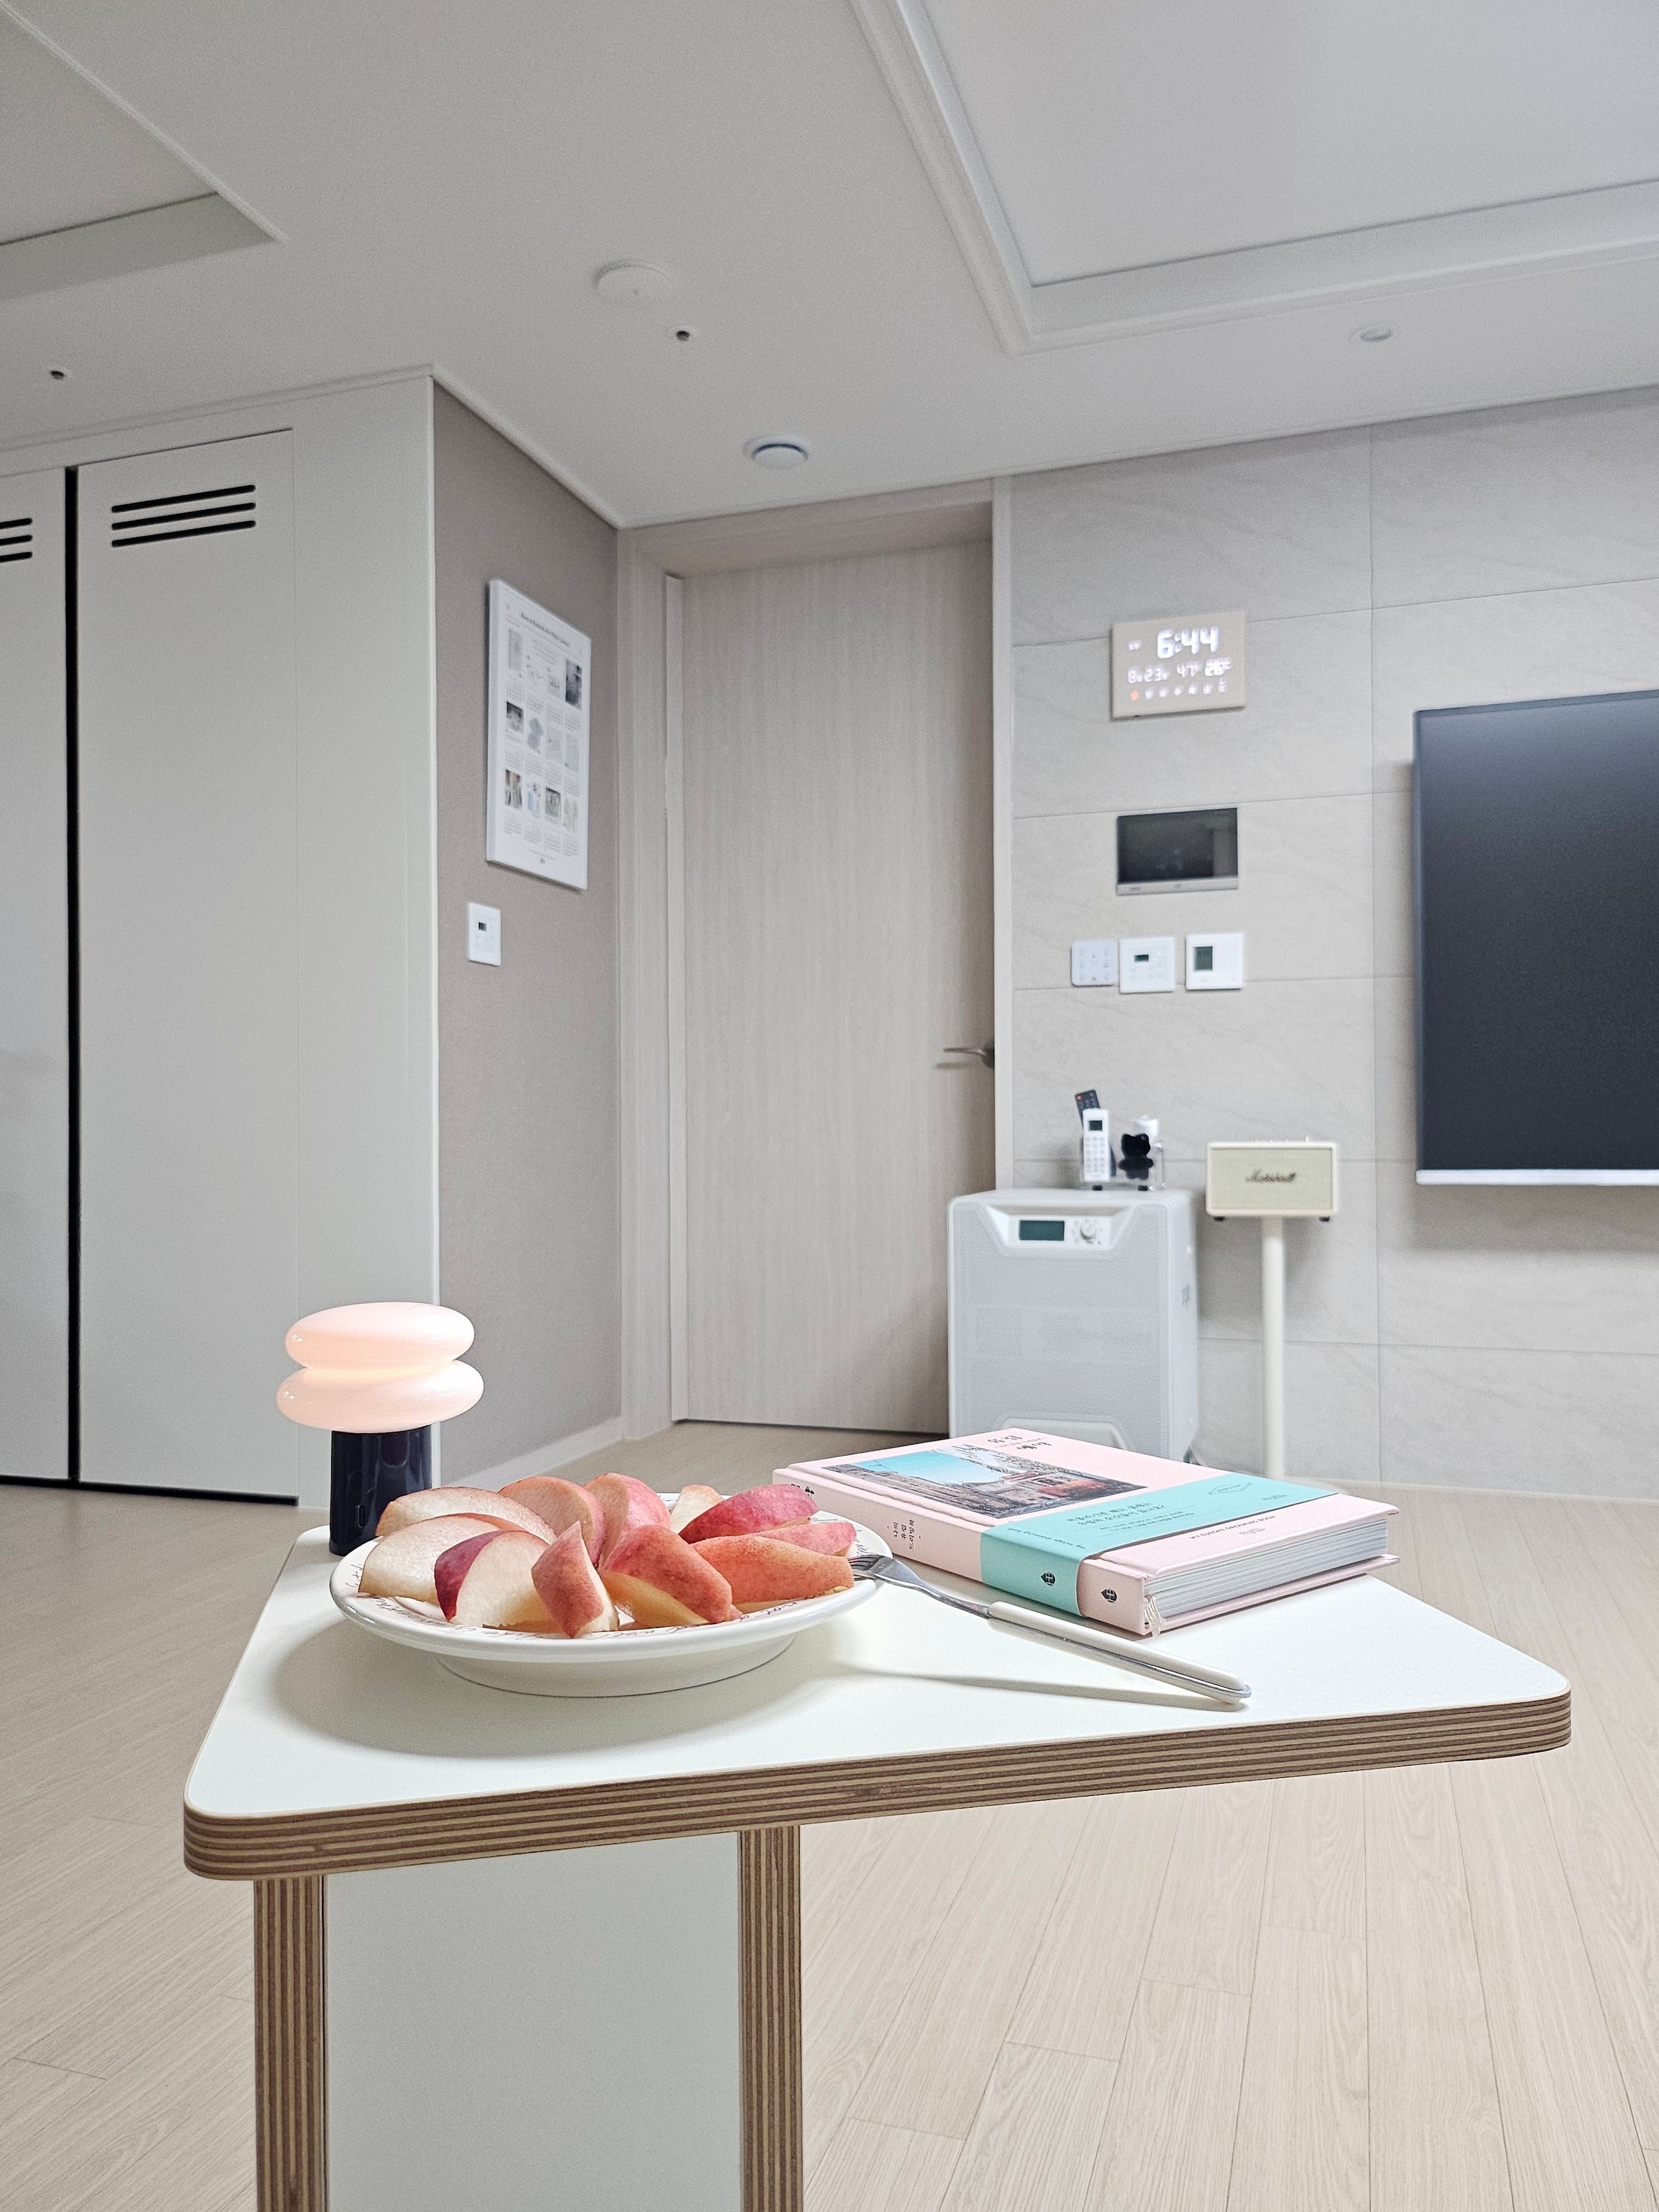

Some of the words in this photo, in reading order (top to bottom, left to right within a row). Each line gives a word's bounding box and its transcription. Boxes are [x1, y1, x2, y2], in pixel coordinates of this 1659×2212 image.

[1157, 625, 1219, 658] 6:44
[893, 1522, 899, 1537] 나의
[901, 1524, 907, 1540] 유럽
